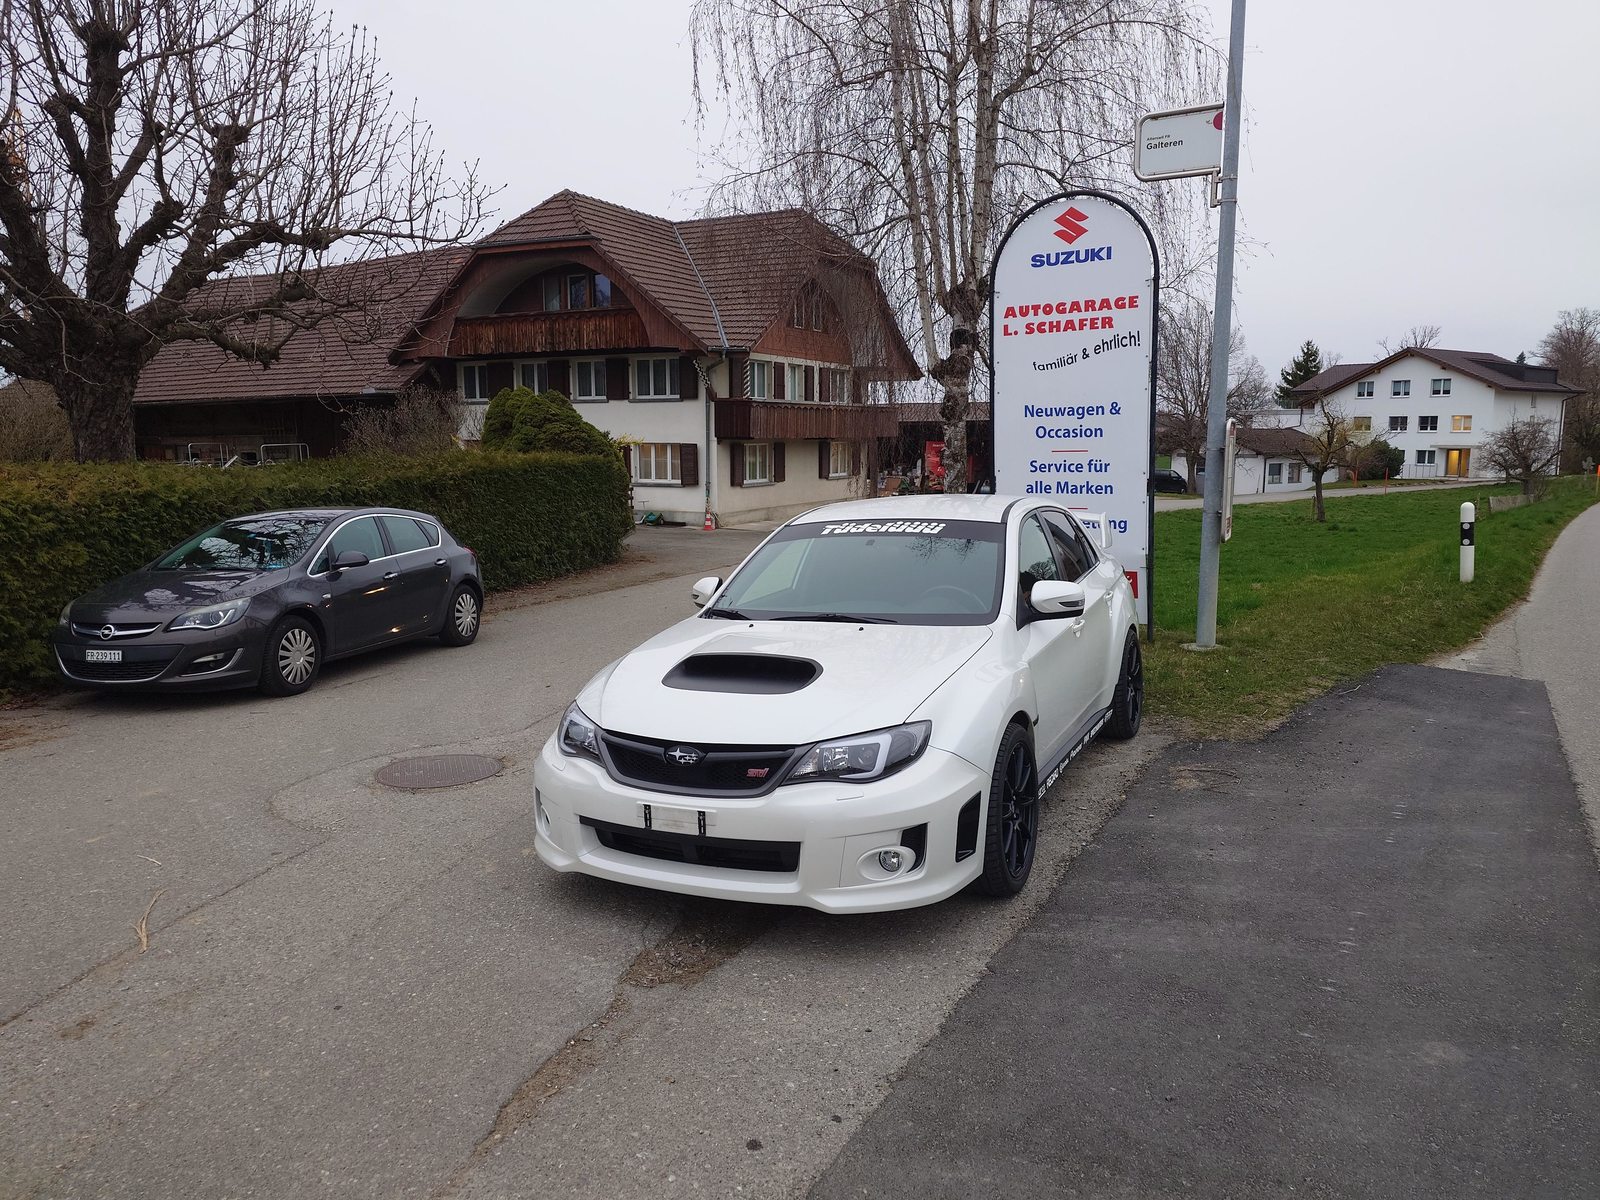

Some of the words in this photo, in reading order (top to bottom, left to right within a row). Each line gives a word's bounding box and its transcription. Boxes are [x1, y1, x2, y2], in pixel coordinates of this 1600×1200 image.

[1146, 139, 1184, 150] Galteren
[1031, 246, 1112, 268] SUZUKI
[1003, 295, 1139, 319] AUTOGARAGE
[1003, 324, 1019, 336] L.
[1025, 316, 1114, 335] SCHAFER
[1033, 353, 1078, 371] familiär
[1082, 348, 1090, 360] &
[1093, 330, 1141, 355] ehrlich!
[1024, 404, 1105, 420] Neuwagen
[1109, 401, 1121, 415] &
[1035, 424, 1104, 439] Occasion
[1029, 460, 1084, 473] Service
[1087, 459, 1111, 473] für
[1026, 481, 1052, 494] alle
[1056, 481, 1114, 494] Marken
